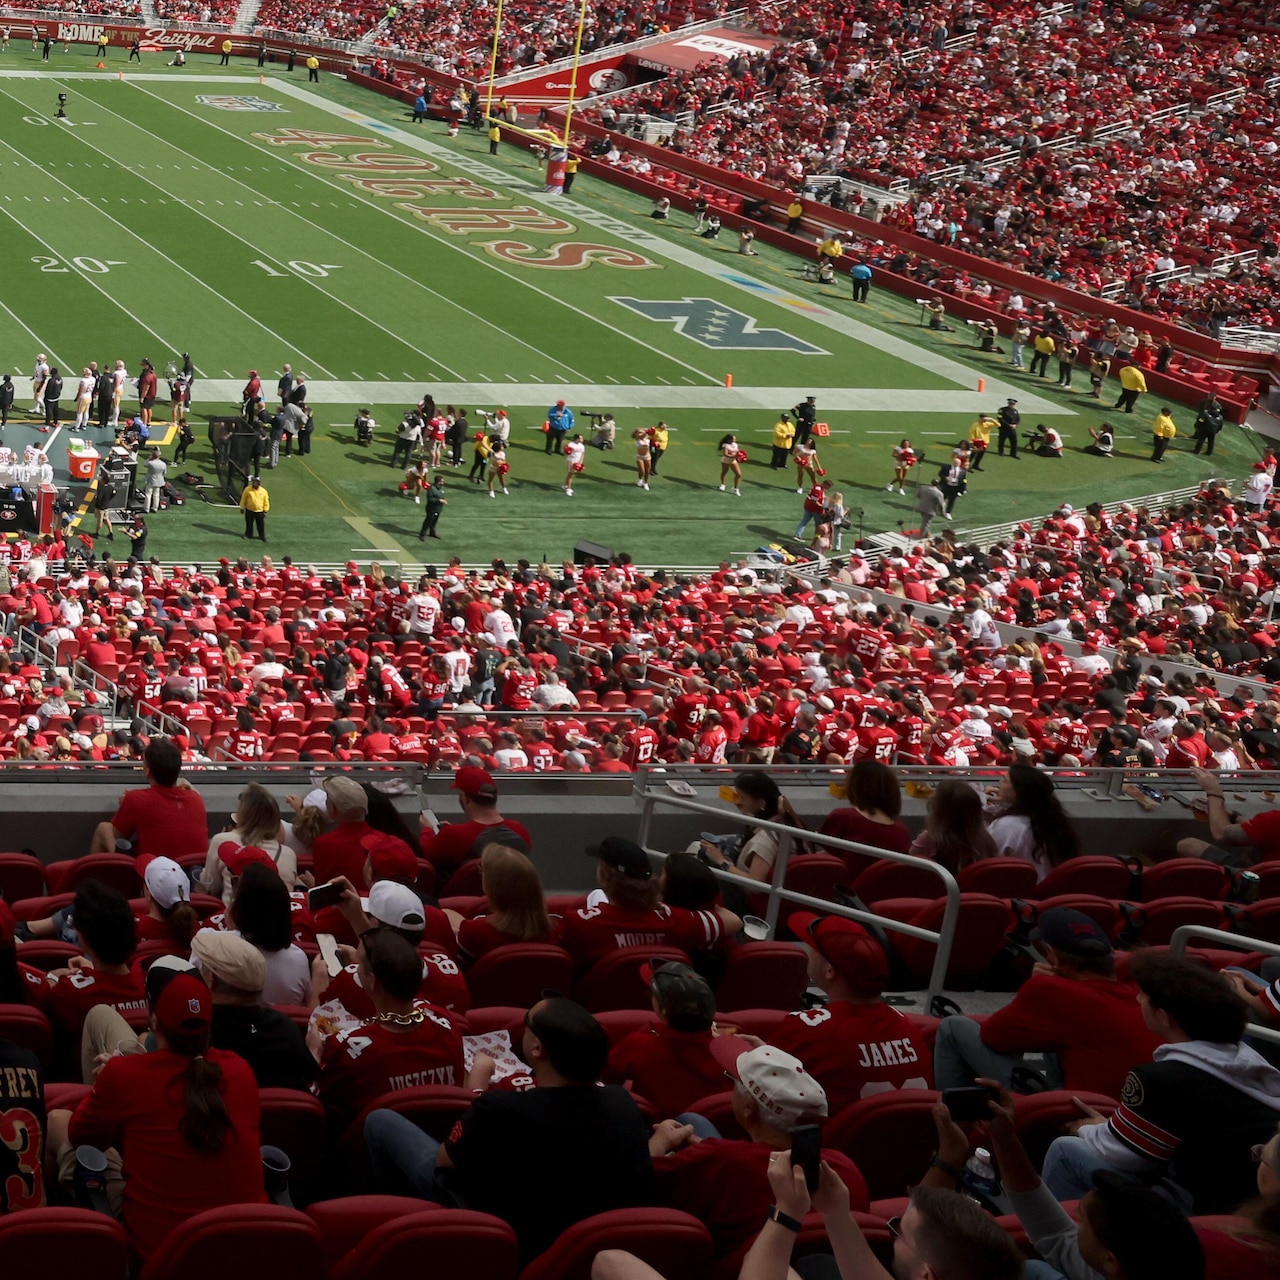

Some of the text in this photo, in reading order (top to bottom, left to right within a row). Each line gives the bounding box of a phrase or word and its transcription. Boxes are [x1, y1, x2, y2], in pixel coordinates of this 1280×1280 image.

[58, 23, 106, 42] HOME
[120, 30, 139, 41] THE
[139, 28, 216, 51] Faithful
[249, 127, 665, 272] 49ERS
[548, 199, 657, 241] CATCH
[31, 255, 112, 274] 20
[250, 260, 331, 278] 10
[79, 461, 92, 474] G
[416, 606, 435, 621] 52
[144, 686, 161, 699] 54
[875, 744, 891, 759] 54
[615, 932, 666, 949] MOORE
[858, 1037, 918, 1068] JAMES
[748, 1080, 784, 1115] 49ERS
